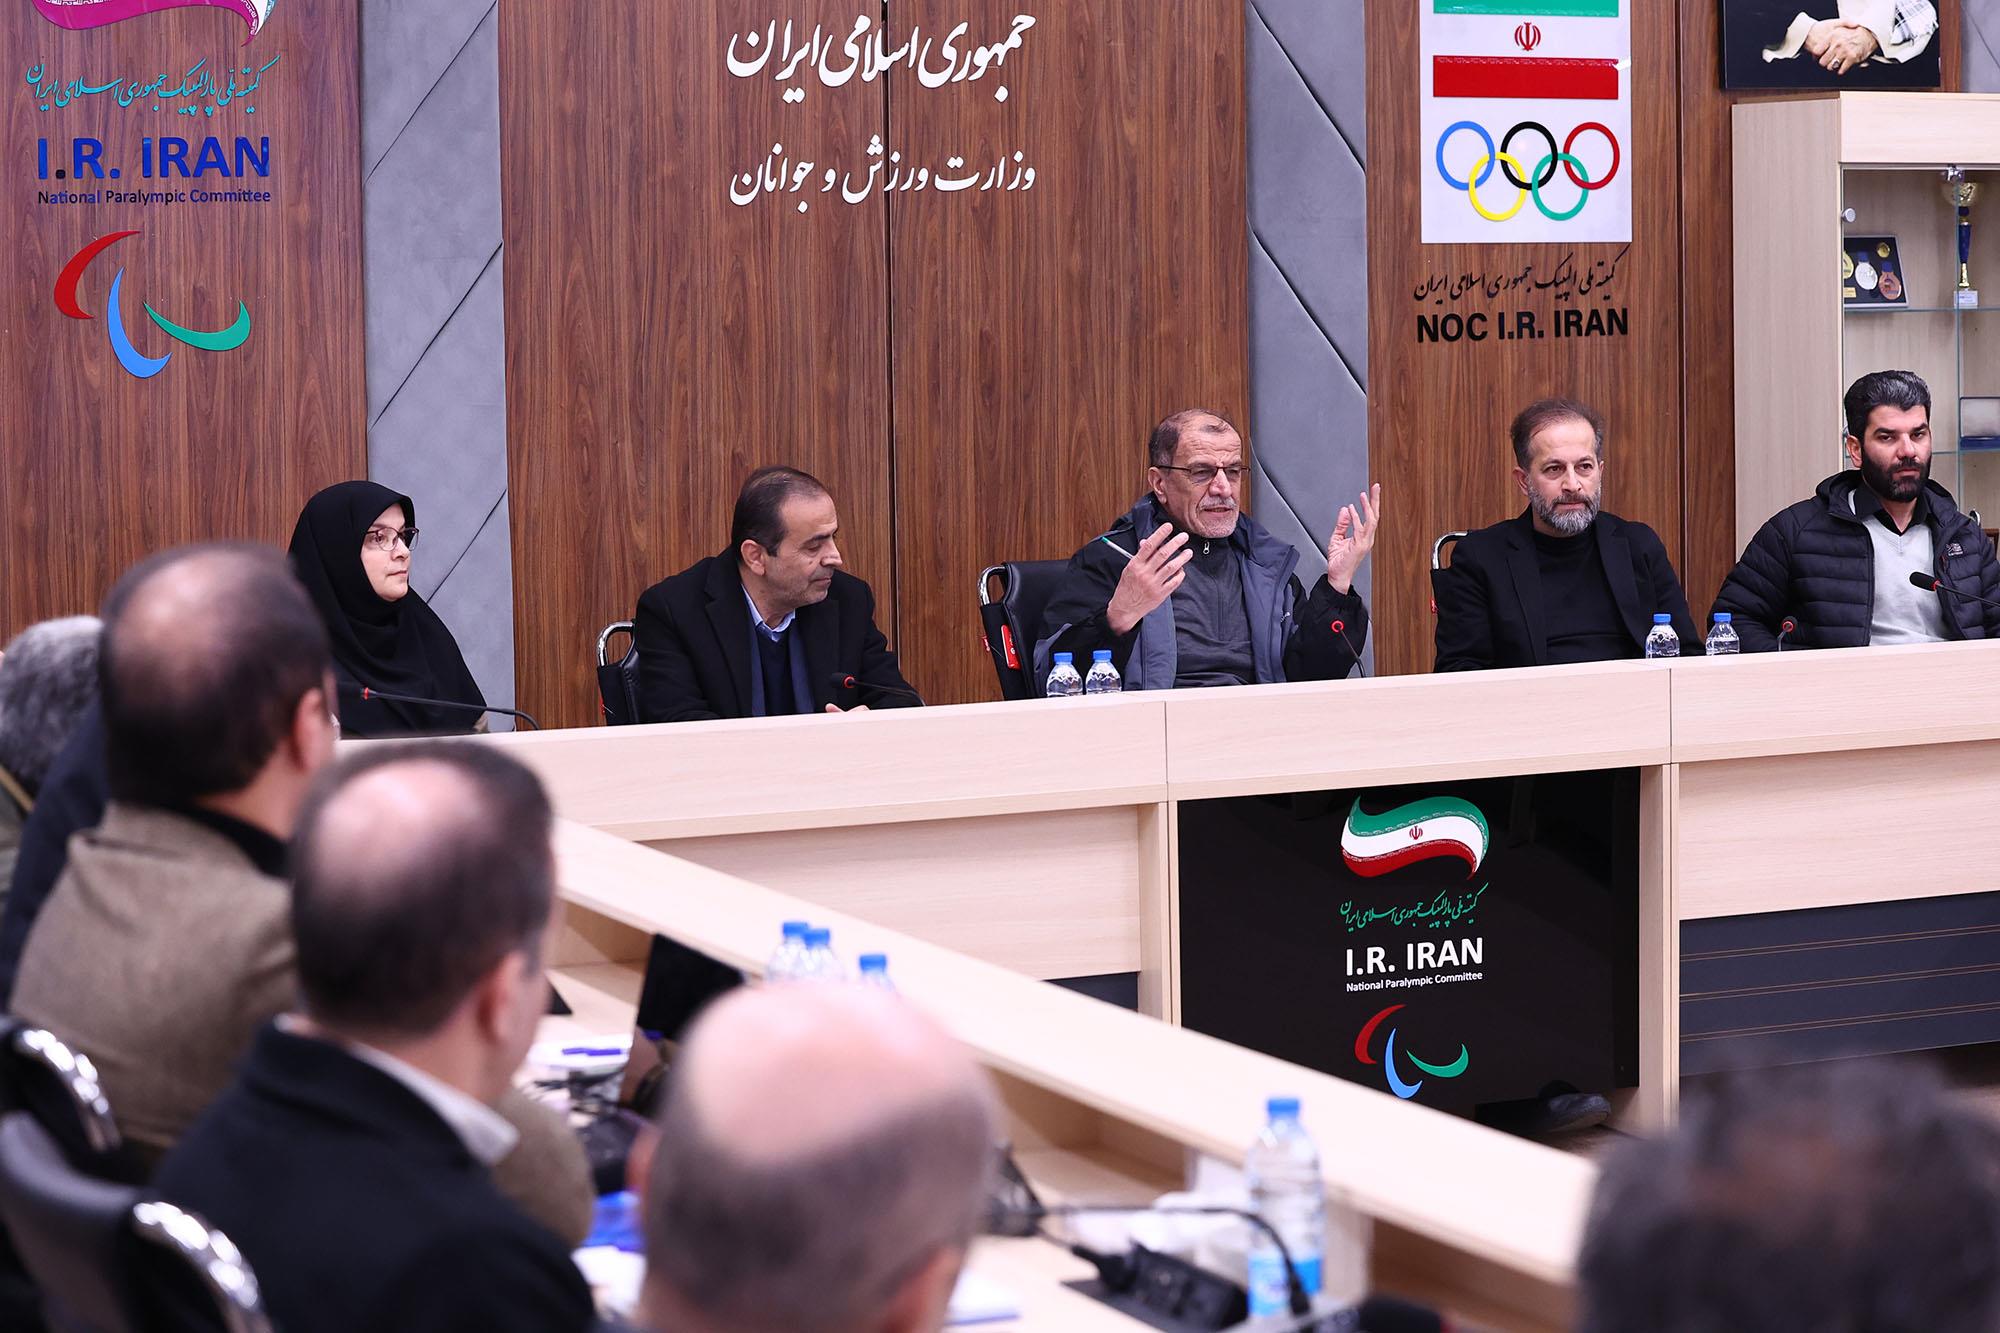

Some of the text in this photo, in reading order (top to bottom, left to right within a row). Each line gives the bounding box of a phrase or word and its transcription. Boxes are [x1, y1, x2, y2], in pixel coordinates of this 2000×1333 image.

[726, 14, 1037, 104] جمهوری اسلامی ایران
[25, 54, 281, 117] کمیته ملی پارالمپیک جمهوری اسلامی ایران
[37, 136, 270, 180] I.R. IRAN
[729, 134, 1037, 214] وزارت ورزش و جوانان
[37, 188, 271, 206] National Paralympic Committee
[1413, 243, 1631, 305] کمیته ملی المپیک جمهوری اسلامی ایران
[1416, 308, 1629, 343] NOC I.R. IRAN
[1340, 882, 1489, 932] کمیته ملی پارالمپیک جمهوری اسلامی ایران
[1346, 937, 1483, 976] I.R. IRAN
[1346, 972, 1483, 992] National Paralympic Committee
